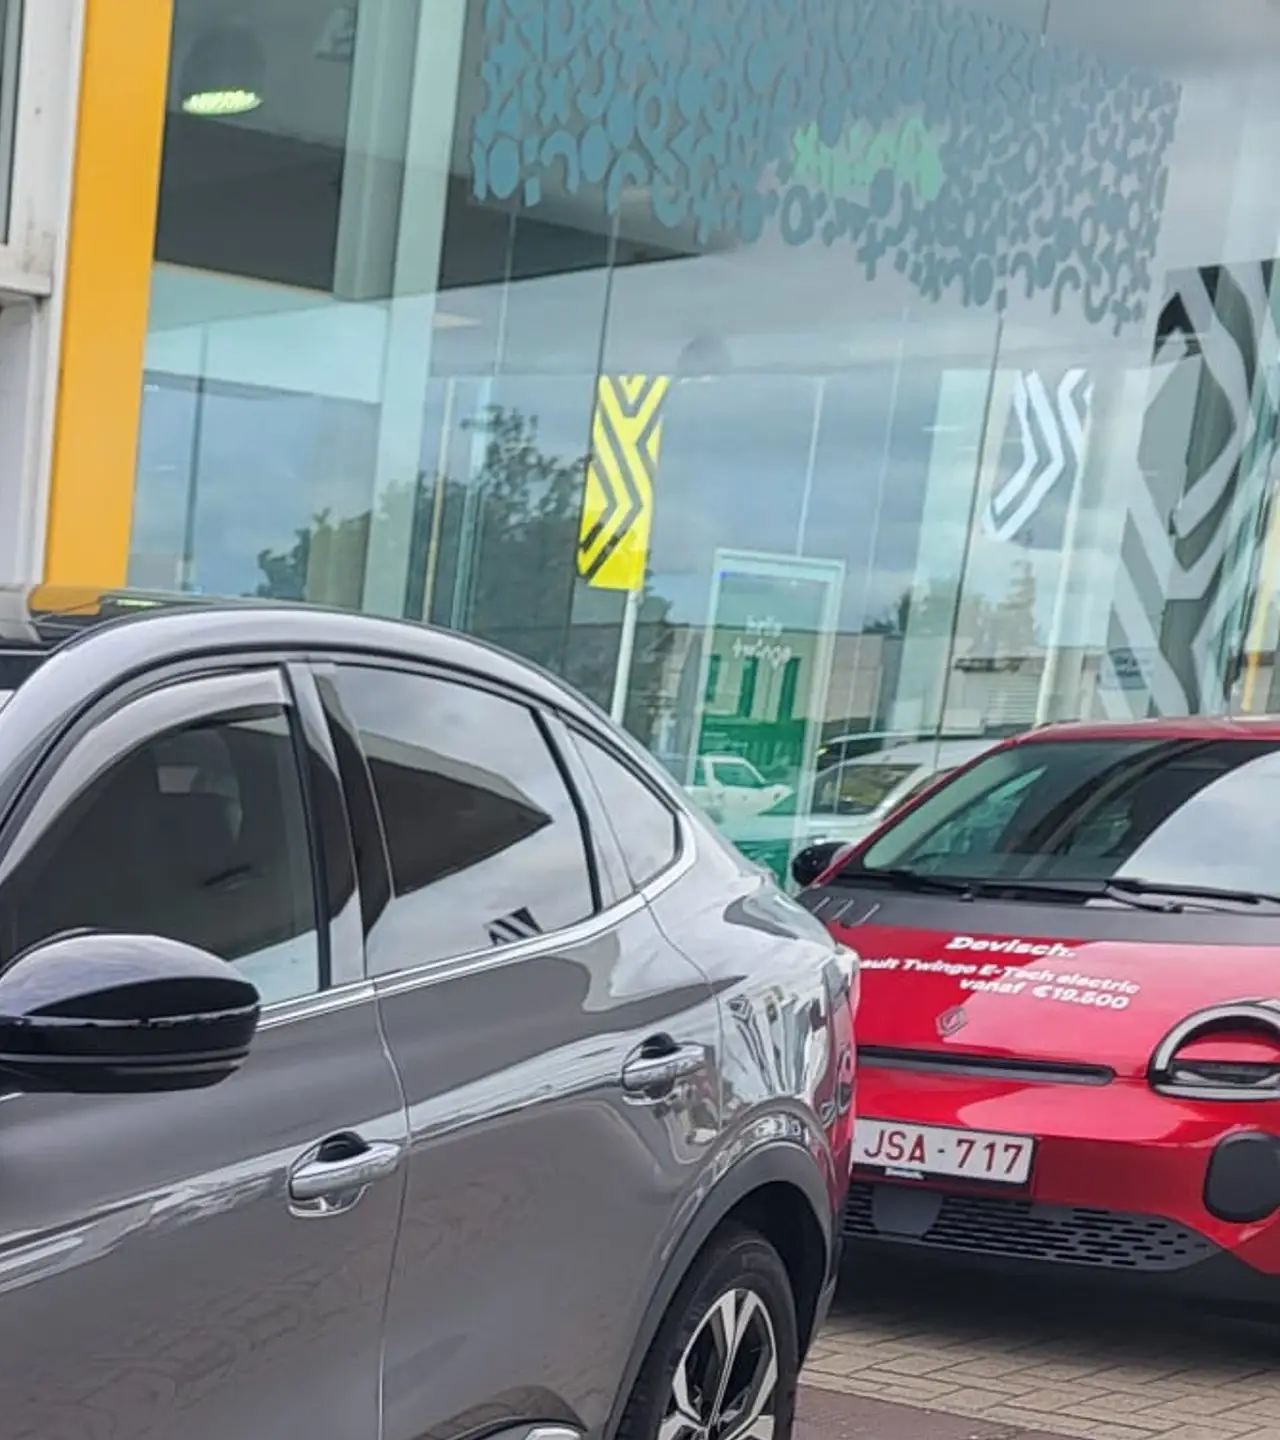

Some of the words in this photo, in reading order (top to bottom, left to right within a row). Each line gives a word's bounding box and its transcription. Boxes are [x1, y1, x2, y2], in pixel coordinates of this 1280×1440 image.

[945, 936, 1077, 958] Devisch.
[901, 958, 977, 976] Twingo
[978, 963, 1054, 983] E-Tech
[1056, 972, 1141, 995] electric
[960, 979, 1027, 994] vanaf
